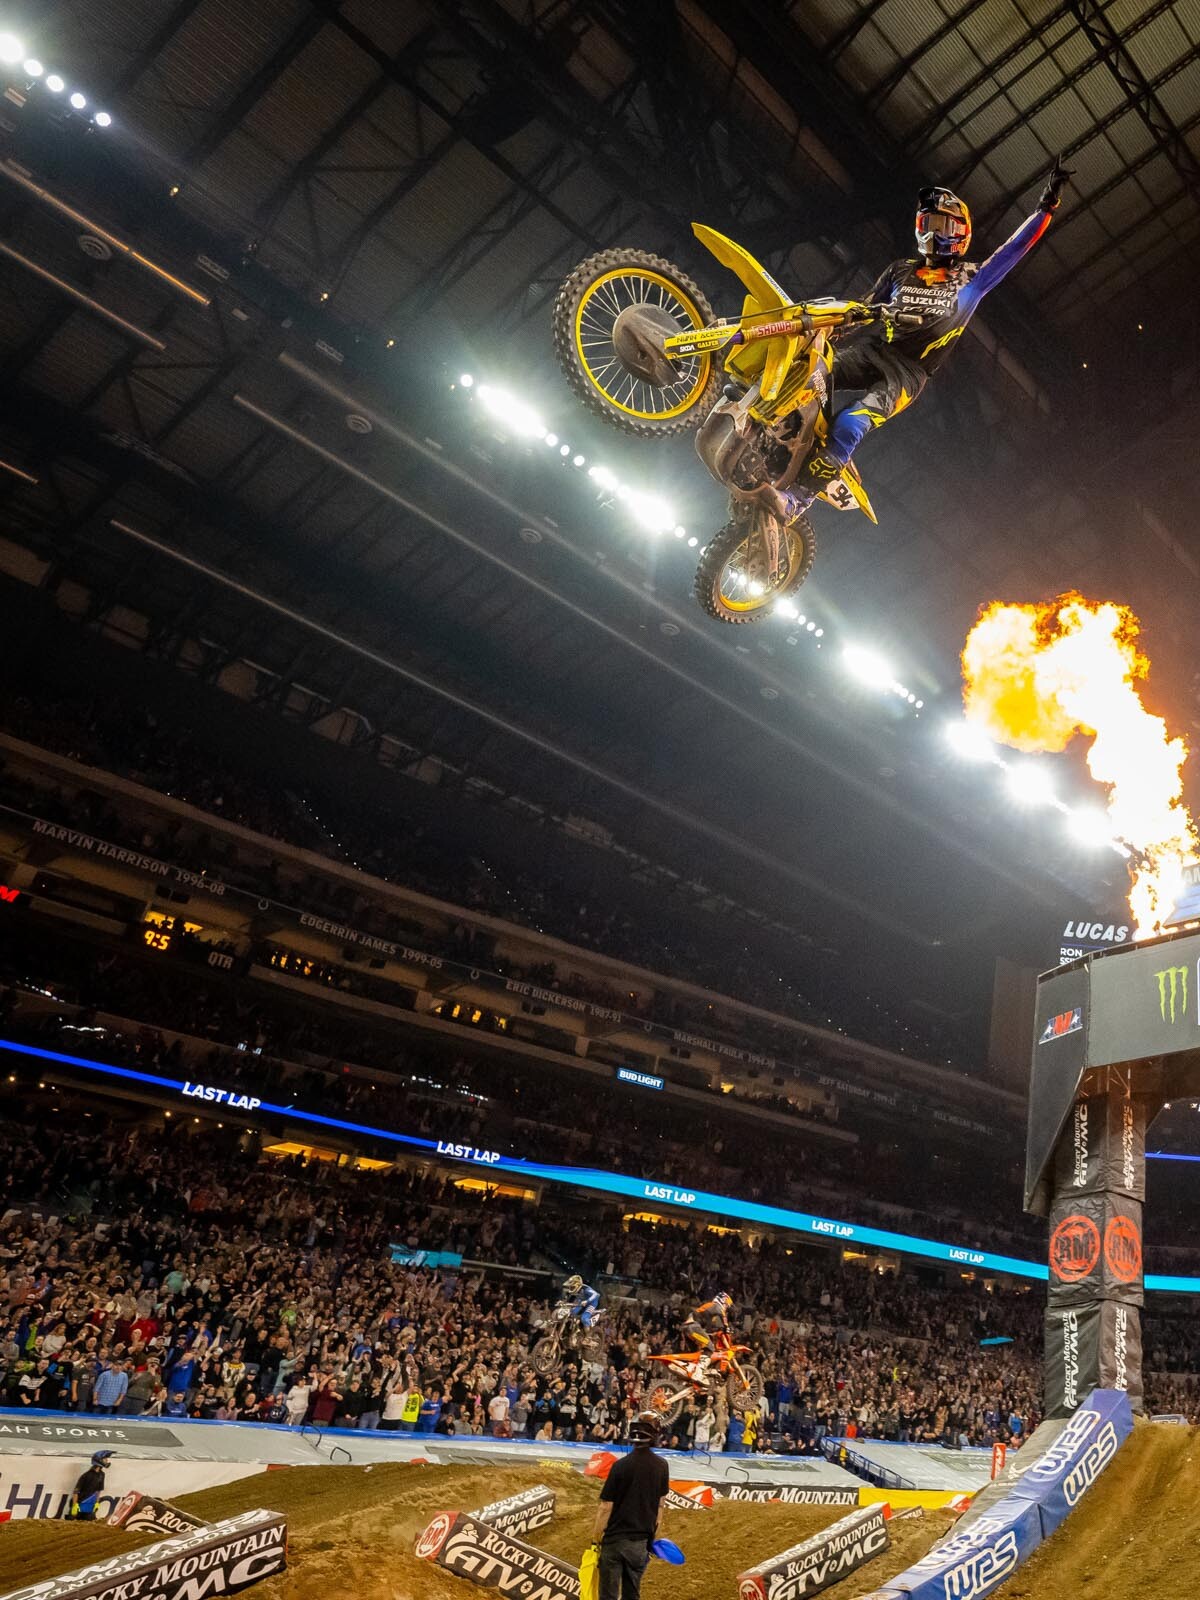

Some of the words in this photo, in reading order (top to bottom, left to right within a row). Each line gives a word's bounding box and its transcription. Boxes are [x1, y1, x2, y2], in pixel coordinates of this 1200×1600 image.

[900, 286, 955, 298] PROGRESSIVE
[902, 295, 951, 308] SUZUKI
[758, 321, 792, 336] SHOWA
[32, 820, 93, 851] MARVIN
[96, 839, 170, 876] HARRISON
[300, 911, 358, 943] EDGERRIN
[359, 935, 396, 955] JAMES
[1063, 921, 1129, 942] LUCAS
[208, 951, 233, 969] QTR
[506, 980, 529, 996] ERIC
[619, 1070, 638, 1081] BUD
[638, 1074, 662, 1088] LIGHT
[182, 1081, 227, 1103] LAST
[227, 1092, 261, 1110] LAP
[437, 1141, 472, 1159] LAST
[474, 1148, 500, 1164] LAP
[644, 1185, 674, 1201] LAST
[674, 1191, 696, 1205] LAP
[812, 1220, 834, 1233] LAST
[835, 1226, 854, 1237] LAP
[950, 1249, 968, 1260] LAST
[969, 1253, 985, 1264] LAP
[1062, 1311, 1072, 1362] MOUNTAIN
[1064, 1363, 1072, 1395] ROCKY
[42, 1426, 127, 1438] SPORTS
[1063, 1421, 1118, 1507] WPS
[666, 1491, 693, 1509] ROCKY
[728, 1486, 780, 1503] ROCKY
[780, 1487, 858, 1506] MOUNTAIN
[495, 1499, 554, 1531] MOUNTAIN
[786, 1551, 826, 1579] ROCKY
[827, 1513, 884, 1558] MOUNTAIN
[149, 1525, 286, 1589] MOUNTAIN
[479, 1531, 533, 1567] ROCKY
[530, 1556, 582, 1597] MOUNT
[944, 1531, 1018, 1600] WPS
